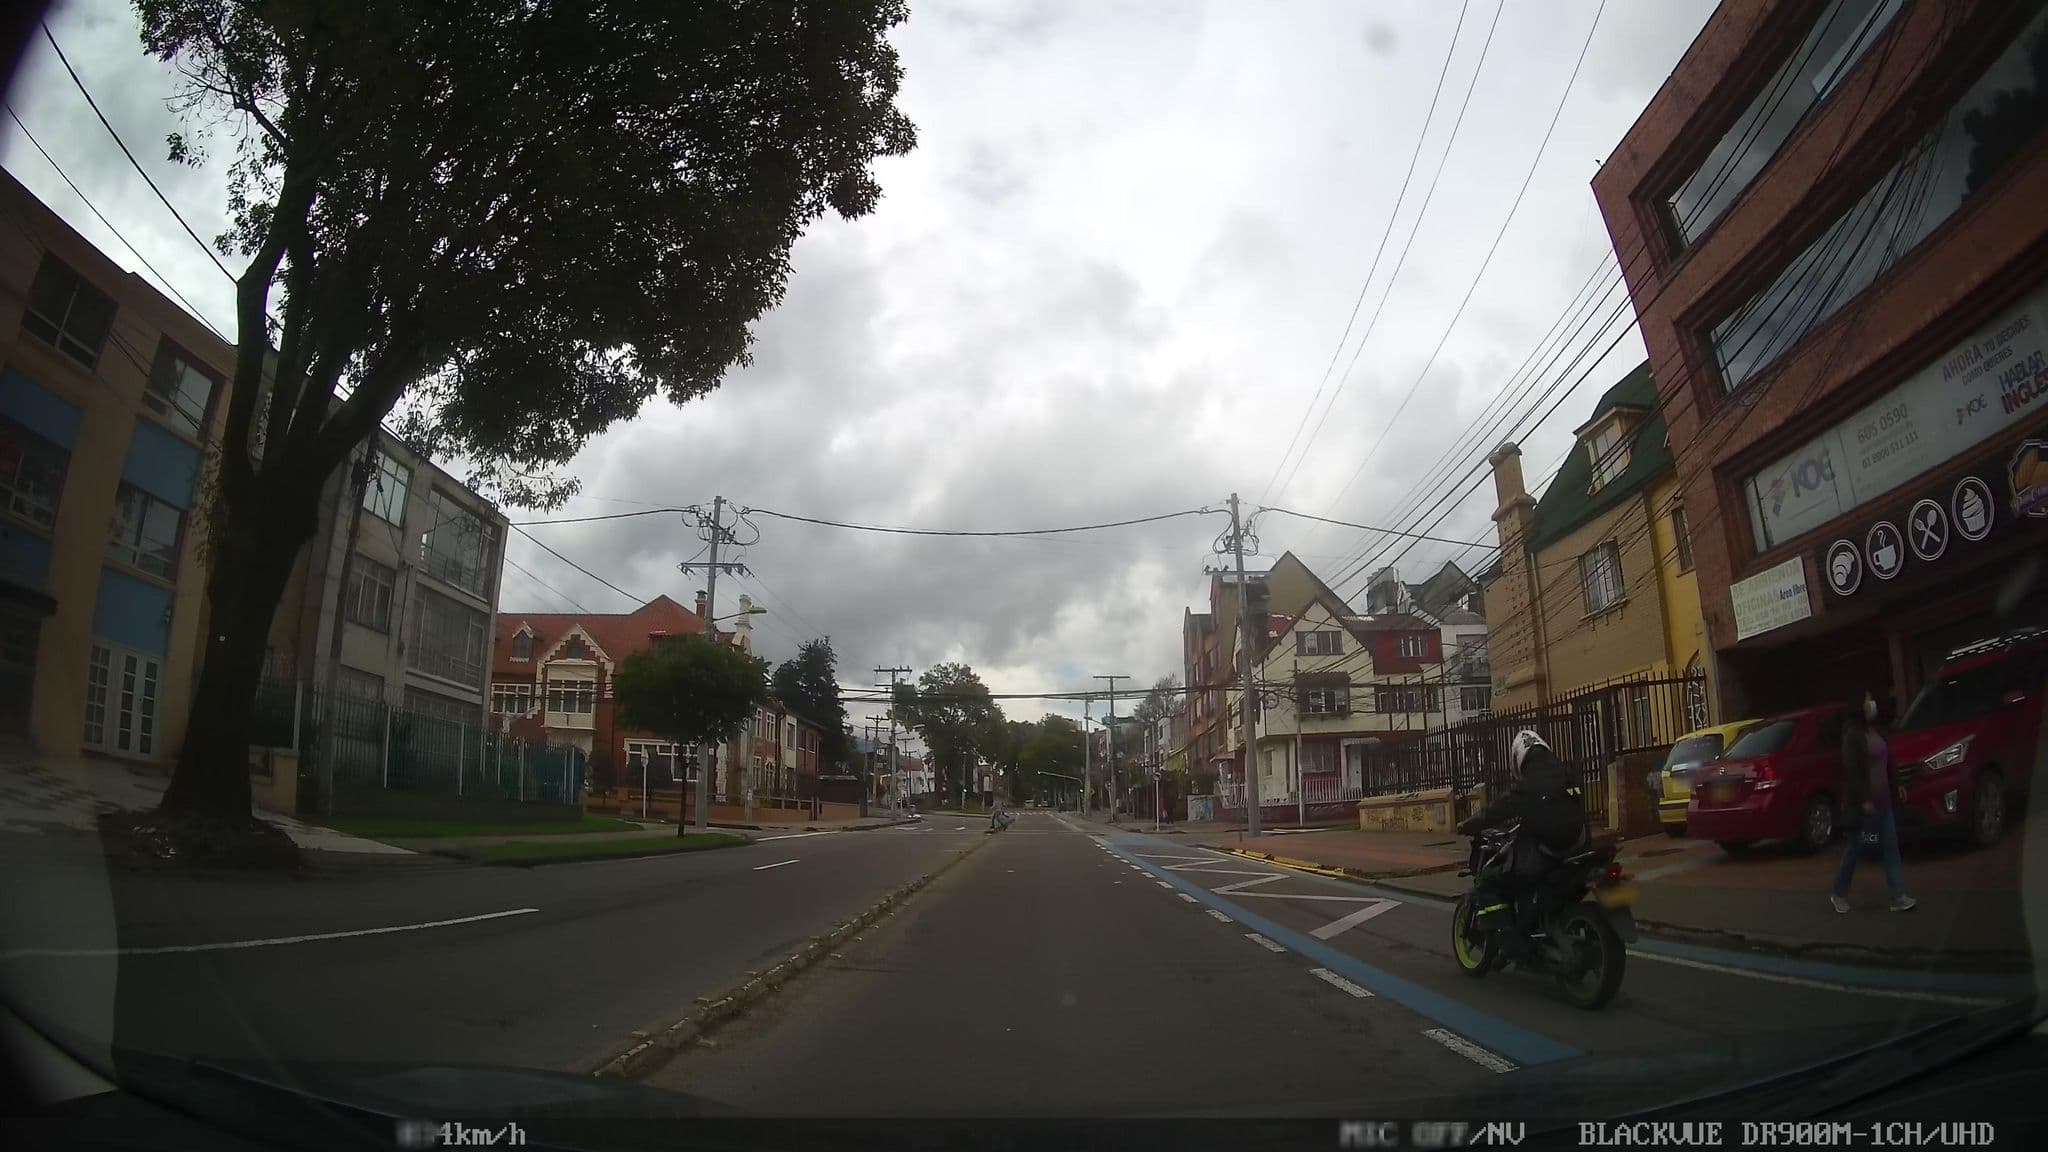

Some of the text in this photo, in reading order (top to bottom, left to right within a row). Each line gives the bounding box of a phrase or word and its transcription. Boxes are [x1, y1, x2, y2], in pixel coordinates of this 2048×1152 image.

[1942, 344, 1983, 382] AHORA
[1998, 350, 2046, 393] HABLAR
[1880, 403, 1908, 430] 0590
